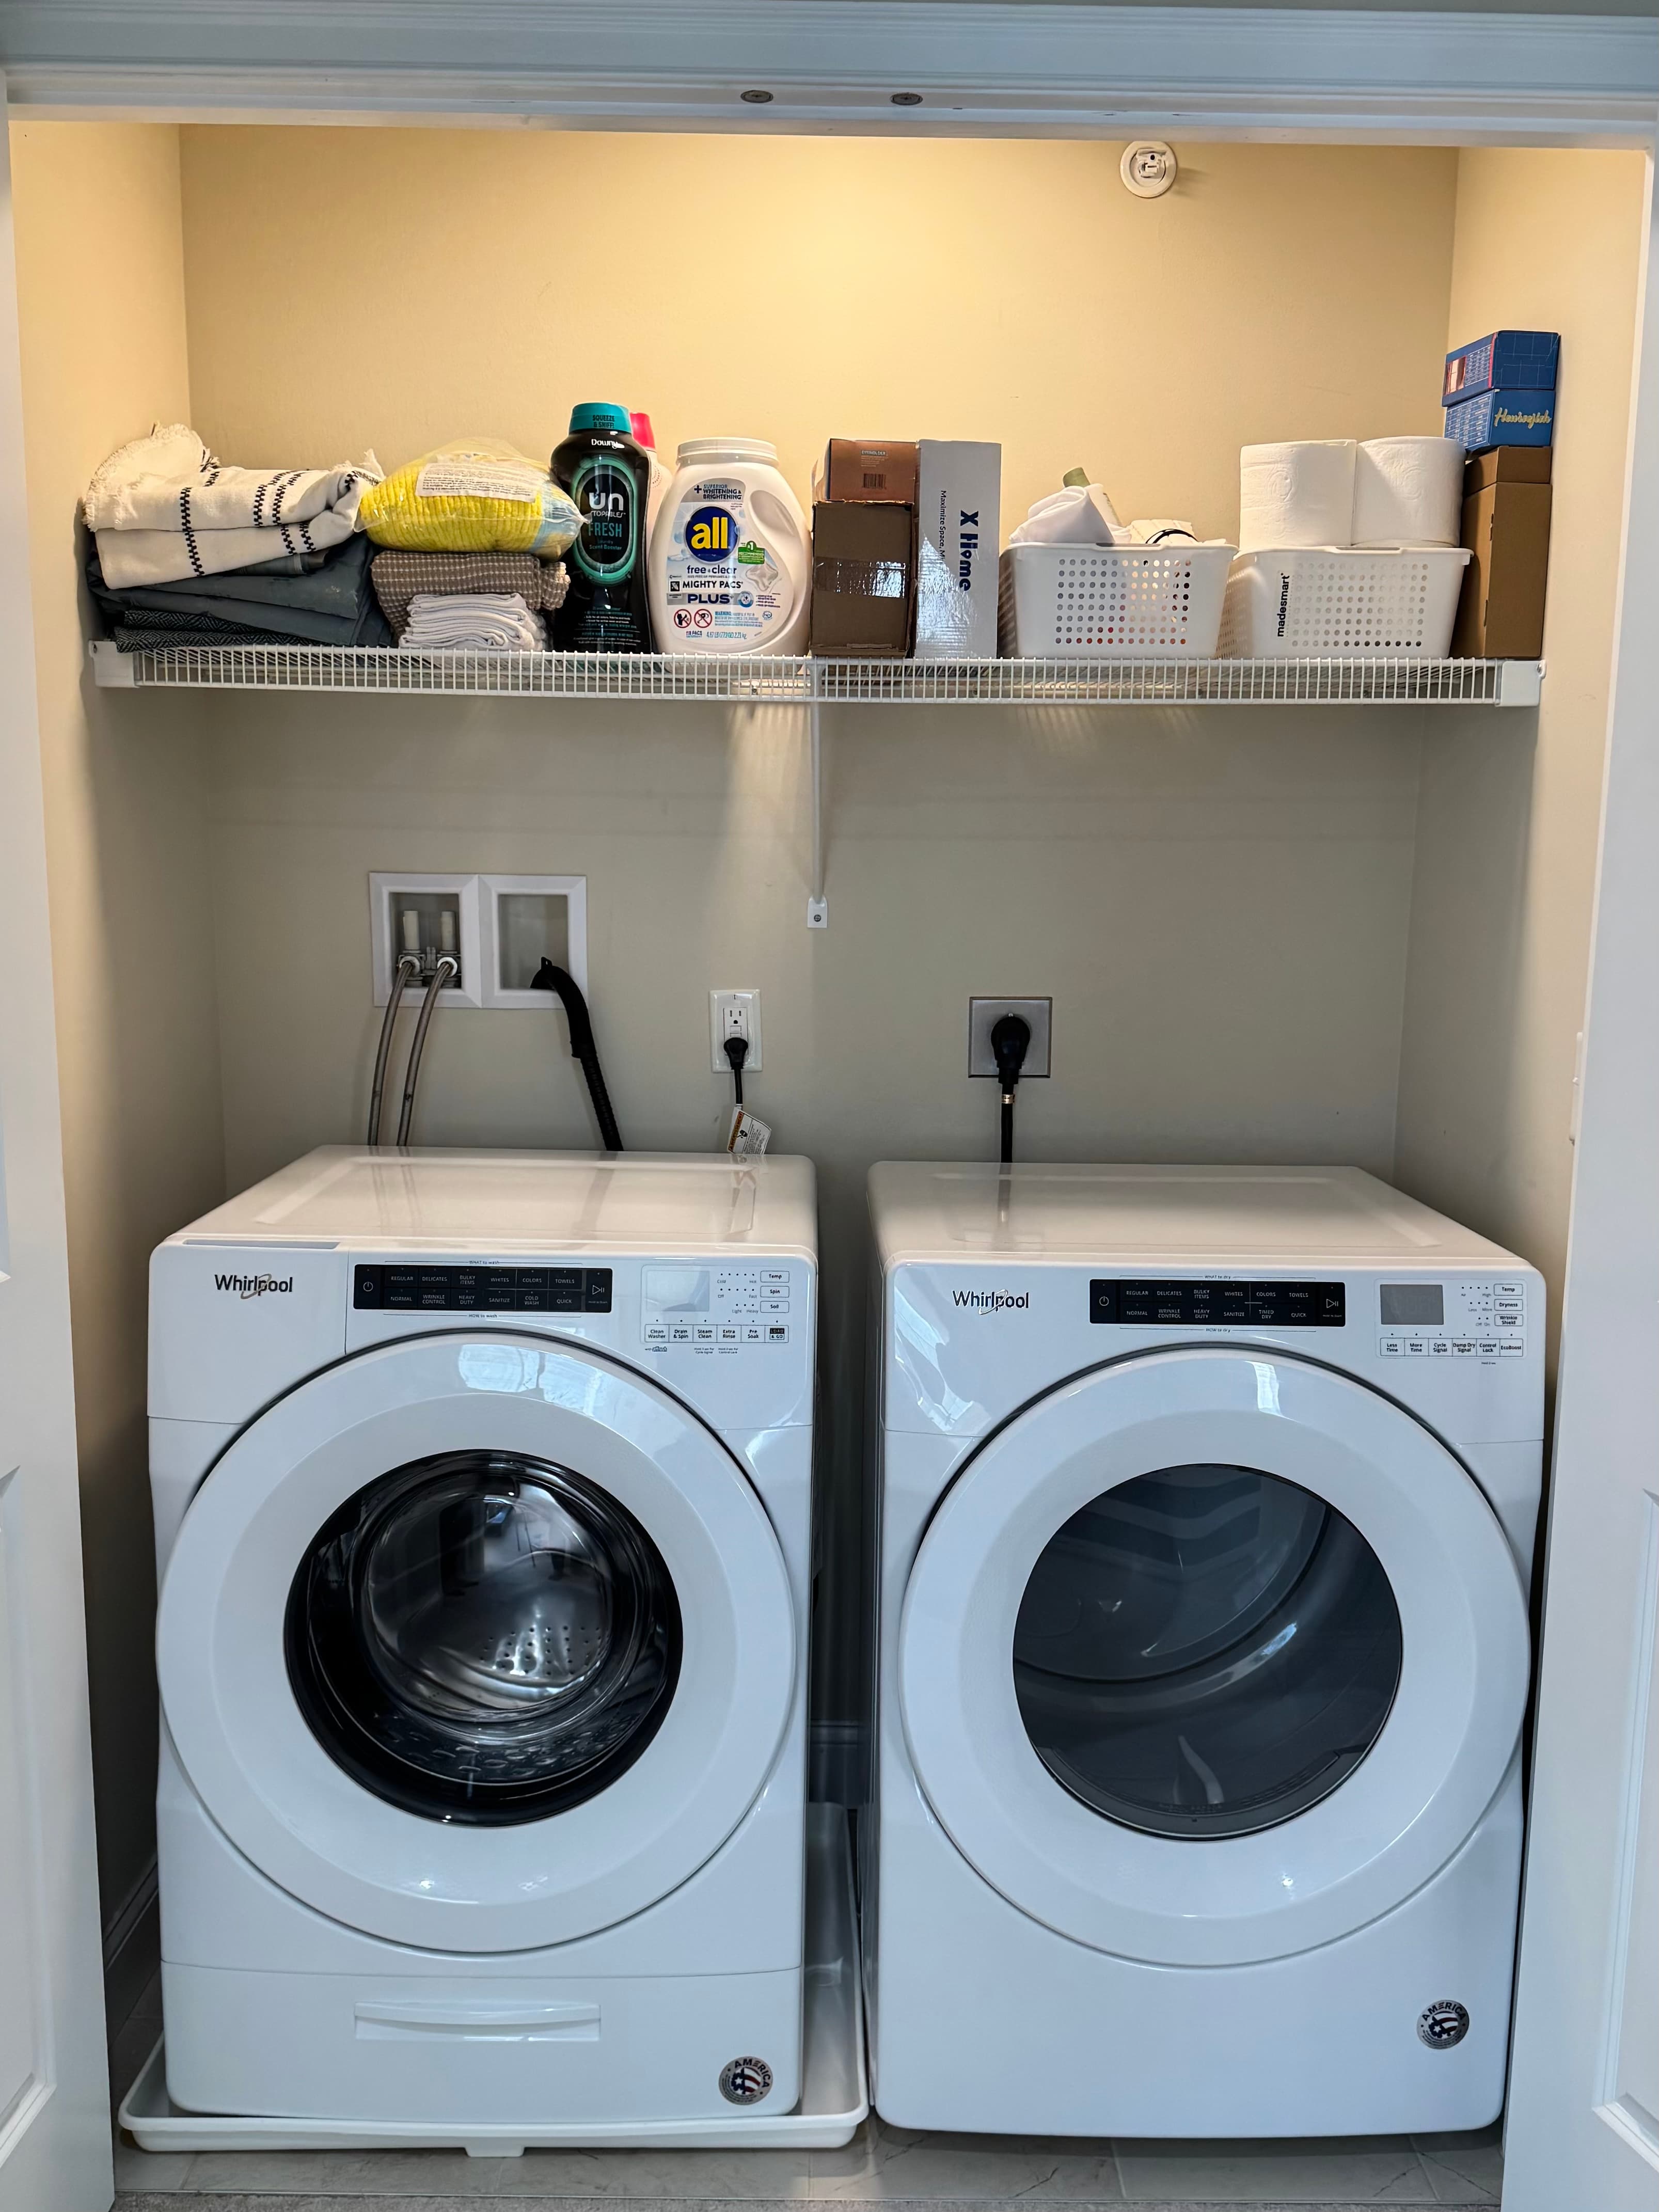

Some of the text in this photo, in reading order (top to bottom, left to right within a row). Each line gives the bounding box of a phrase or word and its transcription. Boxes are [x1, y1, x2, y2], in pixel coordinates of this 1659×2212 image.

[591, 438, 619, 449] Downy
[589, 523, 622, 538] FRESH
[691, 516, 728, 549] all
[959, 510, 979, 591] X Home
[687, 564, 706, 574] free
[712, 564, 737, 574] clear
[1276, 575, 1290, 637] madesmart
[214, 1273, 293, 1297] Whirlpool
[952, 1290, 1029, 1312] Whirlpool
[1421, 2001, 1466, 2021] AMERICA
[734, 2058, 771, 2088] AMERICA
